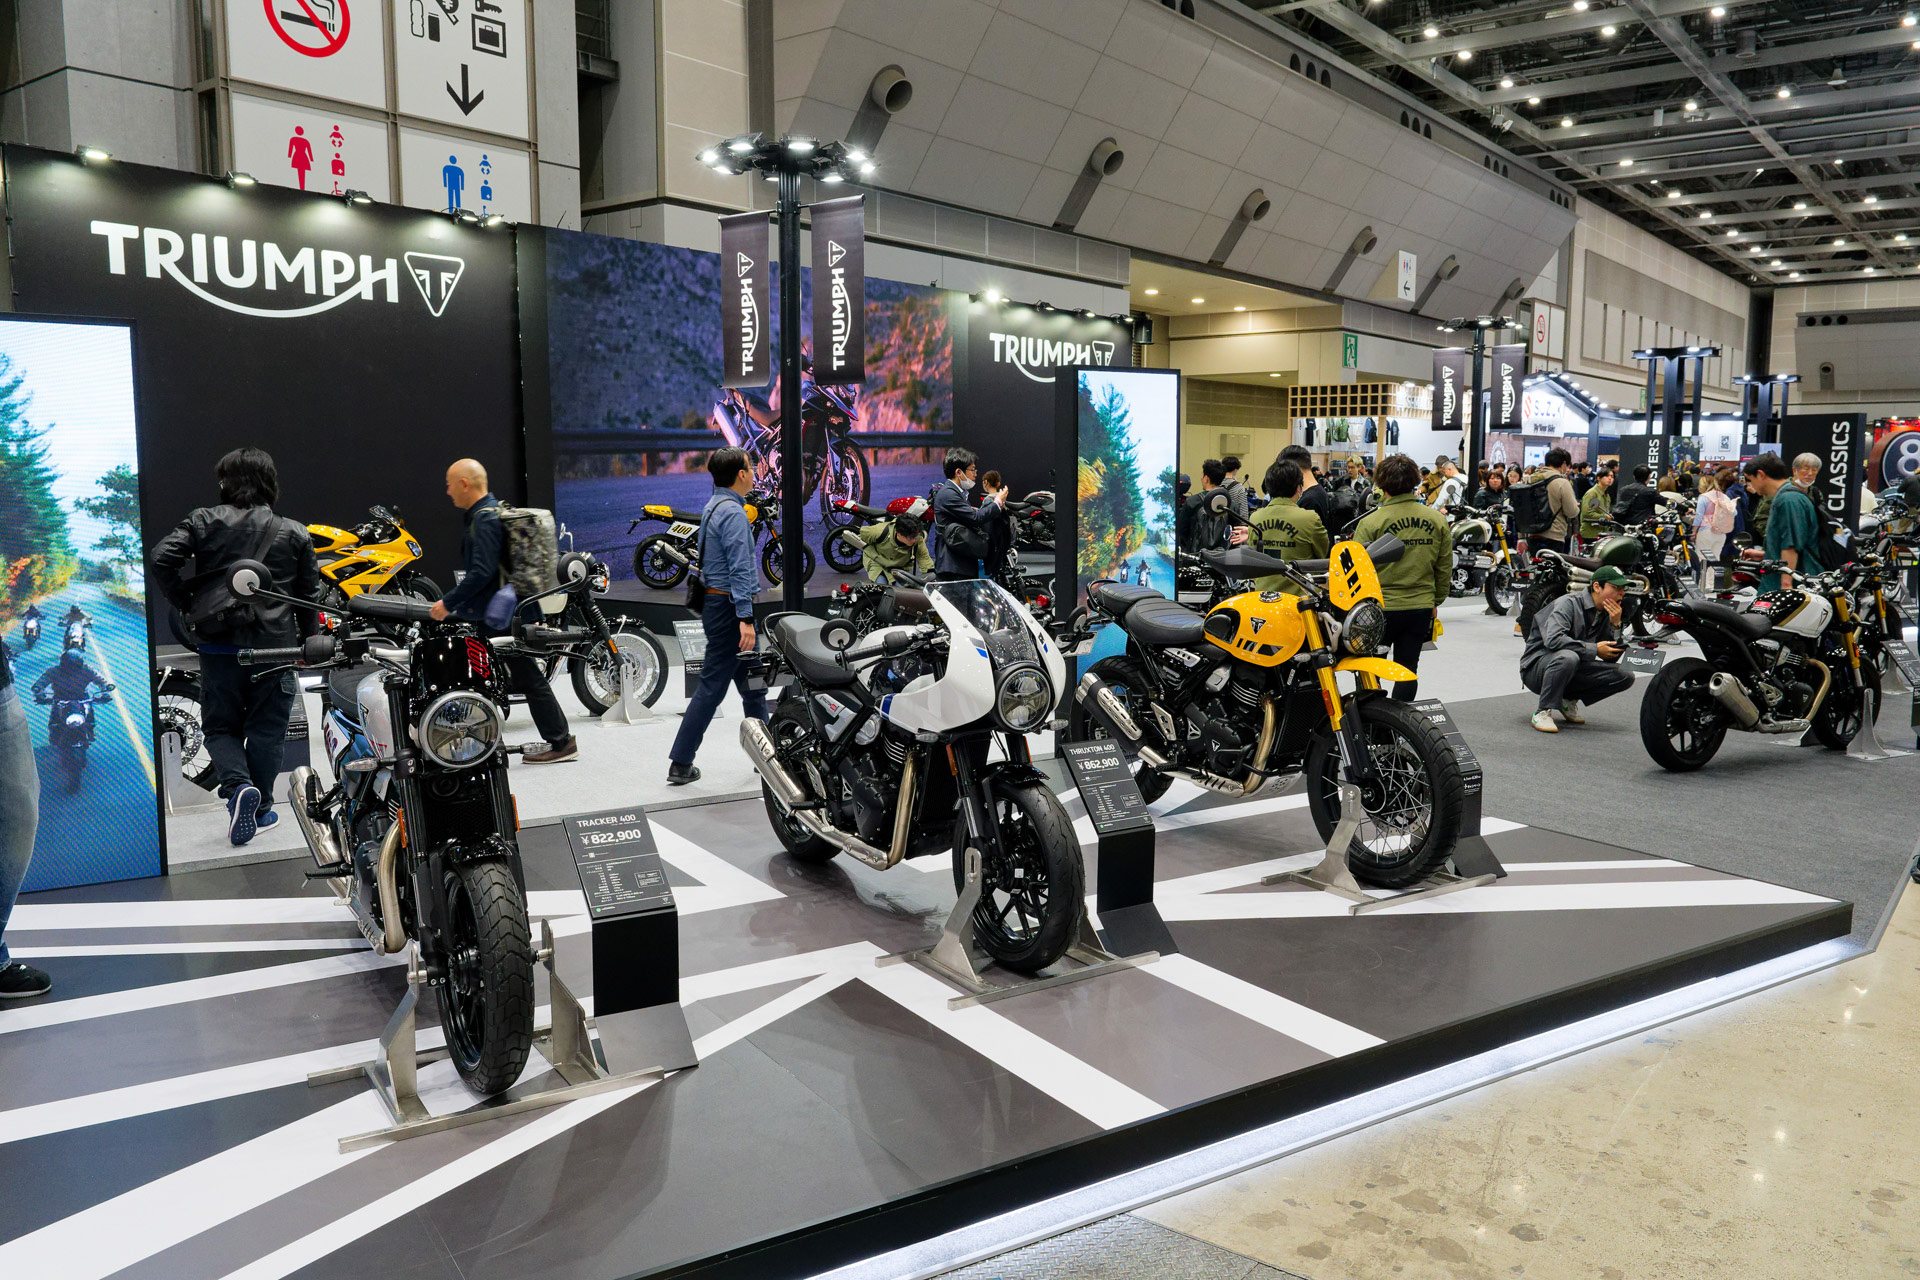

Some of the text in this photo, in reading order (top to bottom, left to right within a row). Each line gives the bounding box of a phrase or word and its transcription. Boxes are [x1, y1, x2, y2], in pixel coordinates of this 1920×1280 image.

[90, 220, 399, 318] TRIUMPH
[742, 277, 760, 377] TRIUMPH
[832, 267, 852, 371] TRIUMPH
[989, 332, 1091, 383] TRIUMPH
[1442, 378, 1456, 426] TRIUMPH
[1501, 376, 1516, 425] TRIUMPH
[1827, 421, 1851, 511] CLASSICS
[671, 524, 693, 536] 400
[1626, 656, 1652, 666] TRIUMPH
[1069, 745, 1102, 755] THRUXTON
[1103, 744, 1115, 752] 400
[576, 816, 618, 828] TRACKER
[620, 814, 636, 823] 400
